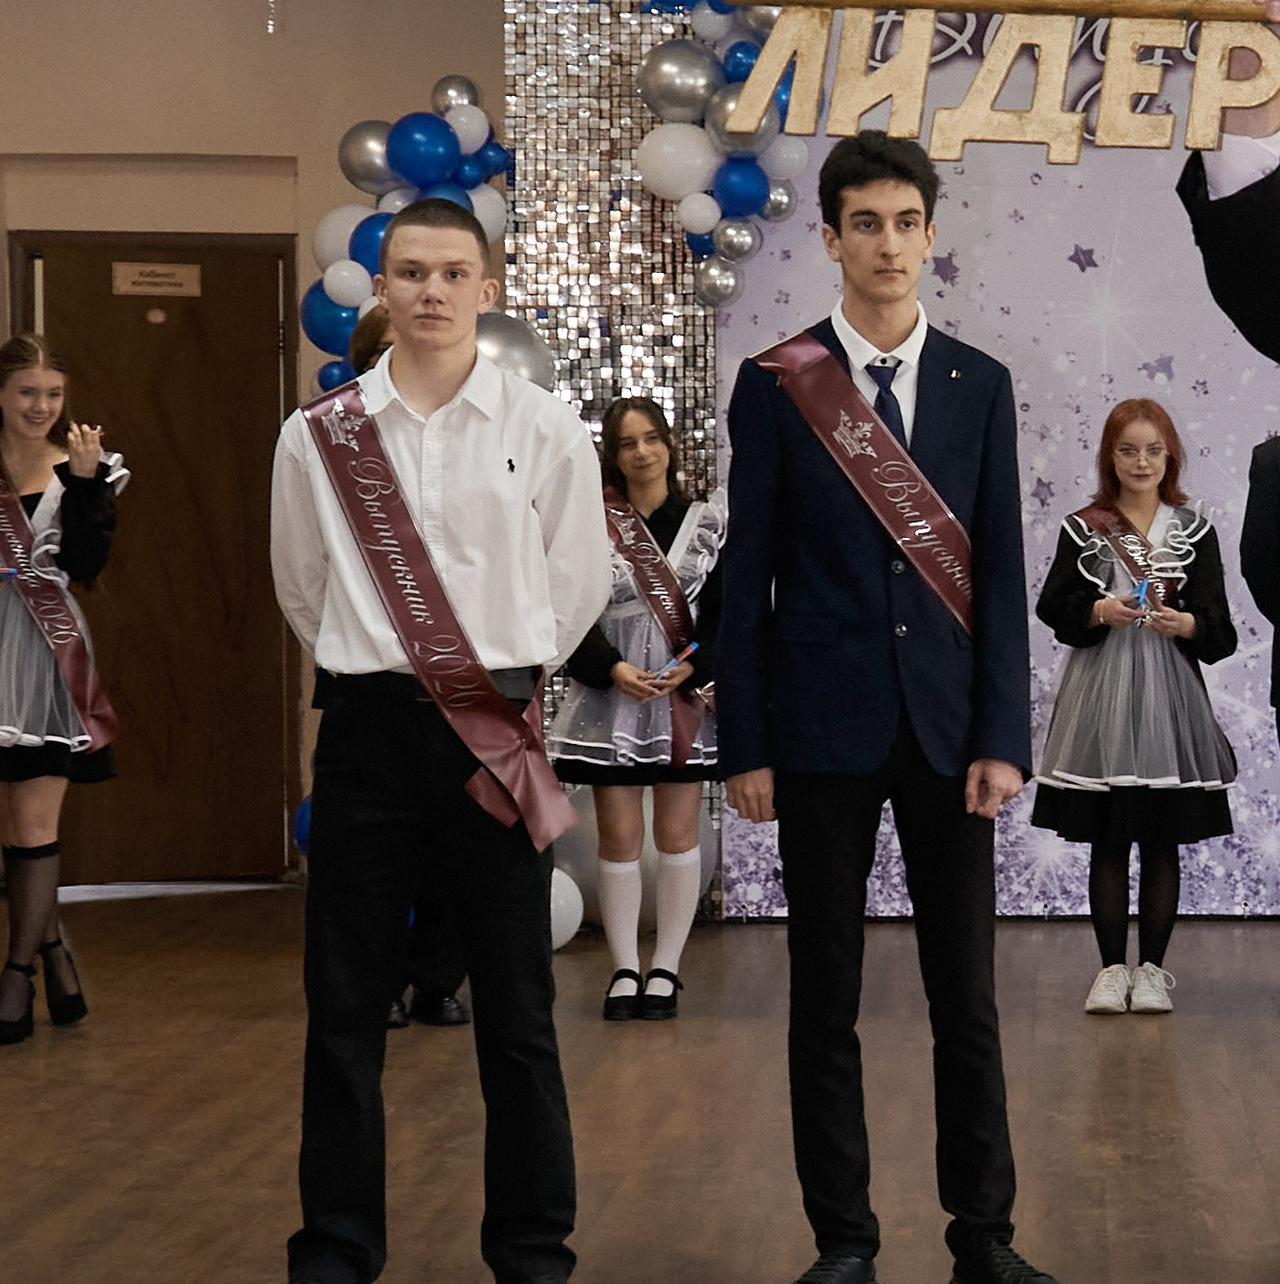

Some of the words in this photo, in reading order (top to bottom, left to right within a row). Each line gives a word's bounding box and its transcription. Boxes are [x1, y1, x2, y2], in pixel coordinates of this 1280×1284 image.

[28, 592, 79, 645] 2026
[346, 456, 435, 626] Выпускник
[413, 633, 485, 709] 2026
